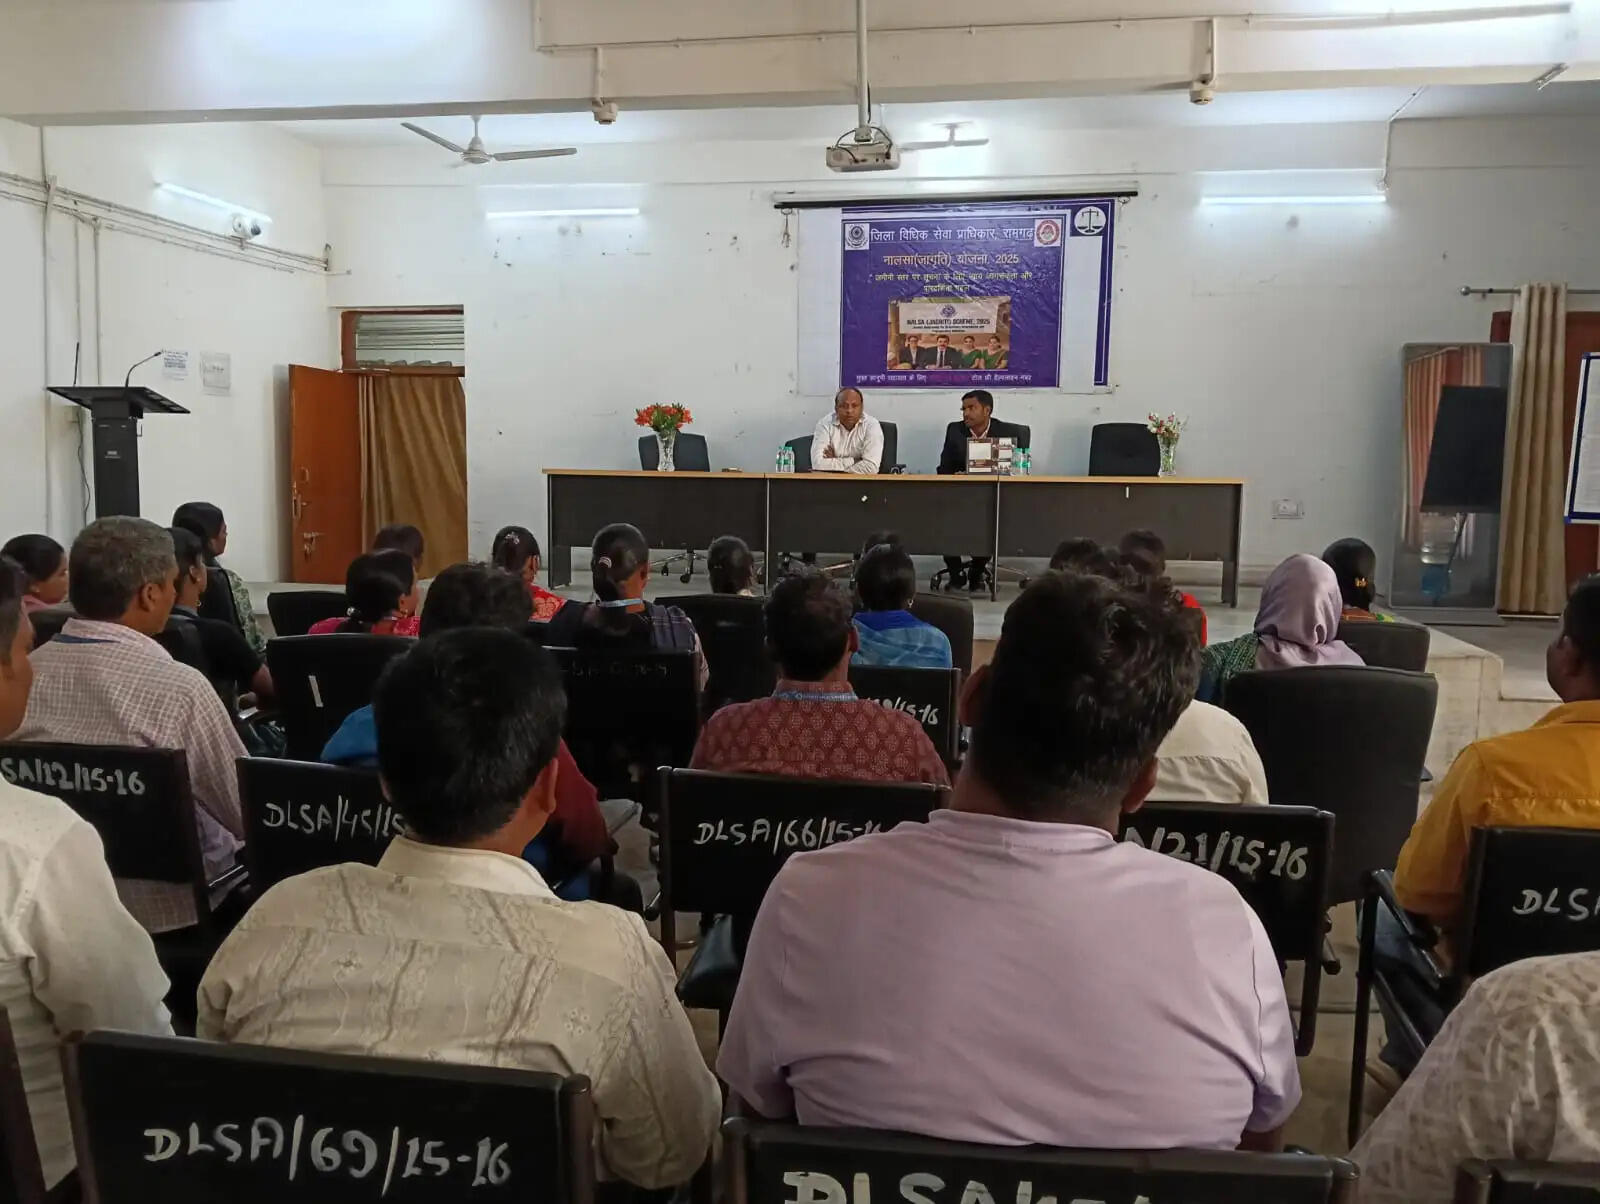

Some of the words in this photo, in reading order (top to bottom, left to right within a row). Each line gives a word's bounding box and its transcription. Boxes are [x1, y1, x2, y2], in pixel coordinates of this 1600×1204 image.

[870, 228, 895, 240] जिला
[900, 227, 928, 240] विधिक
[933, 226, 952, 240] सेवा
[995, 254, 1020, 264] 2025
[144, 1114, 511, 1198] DLSA/69/15-16
